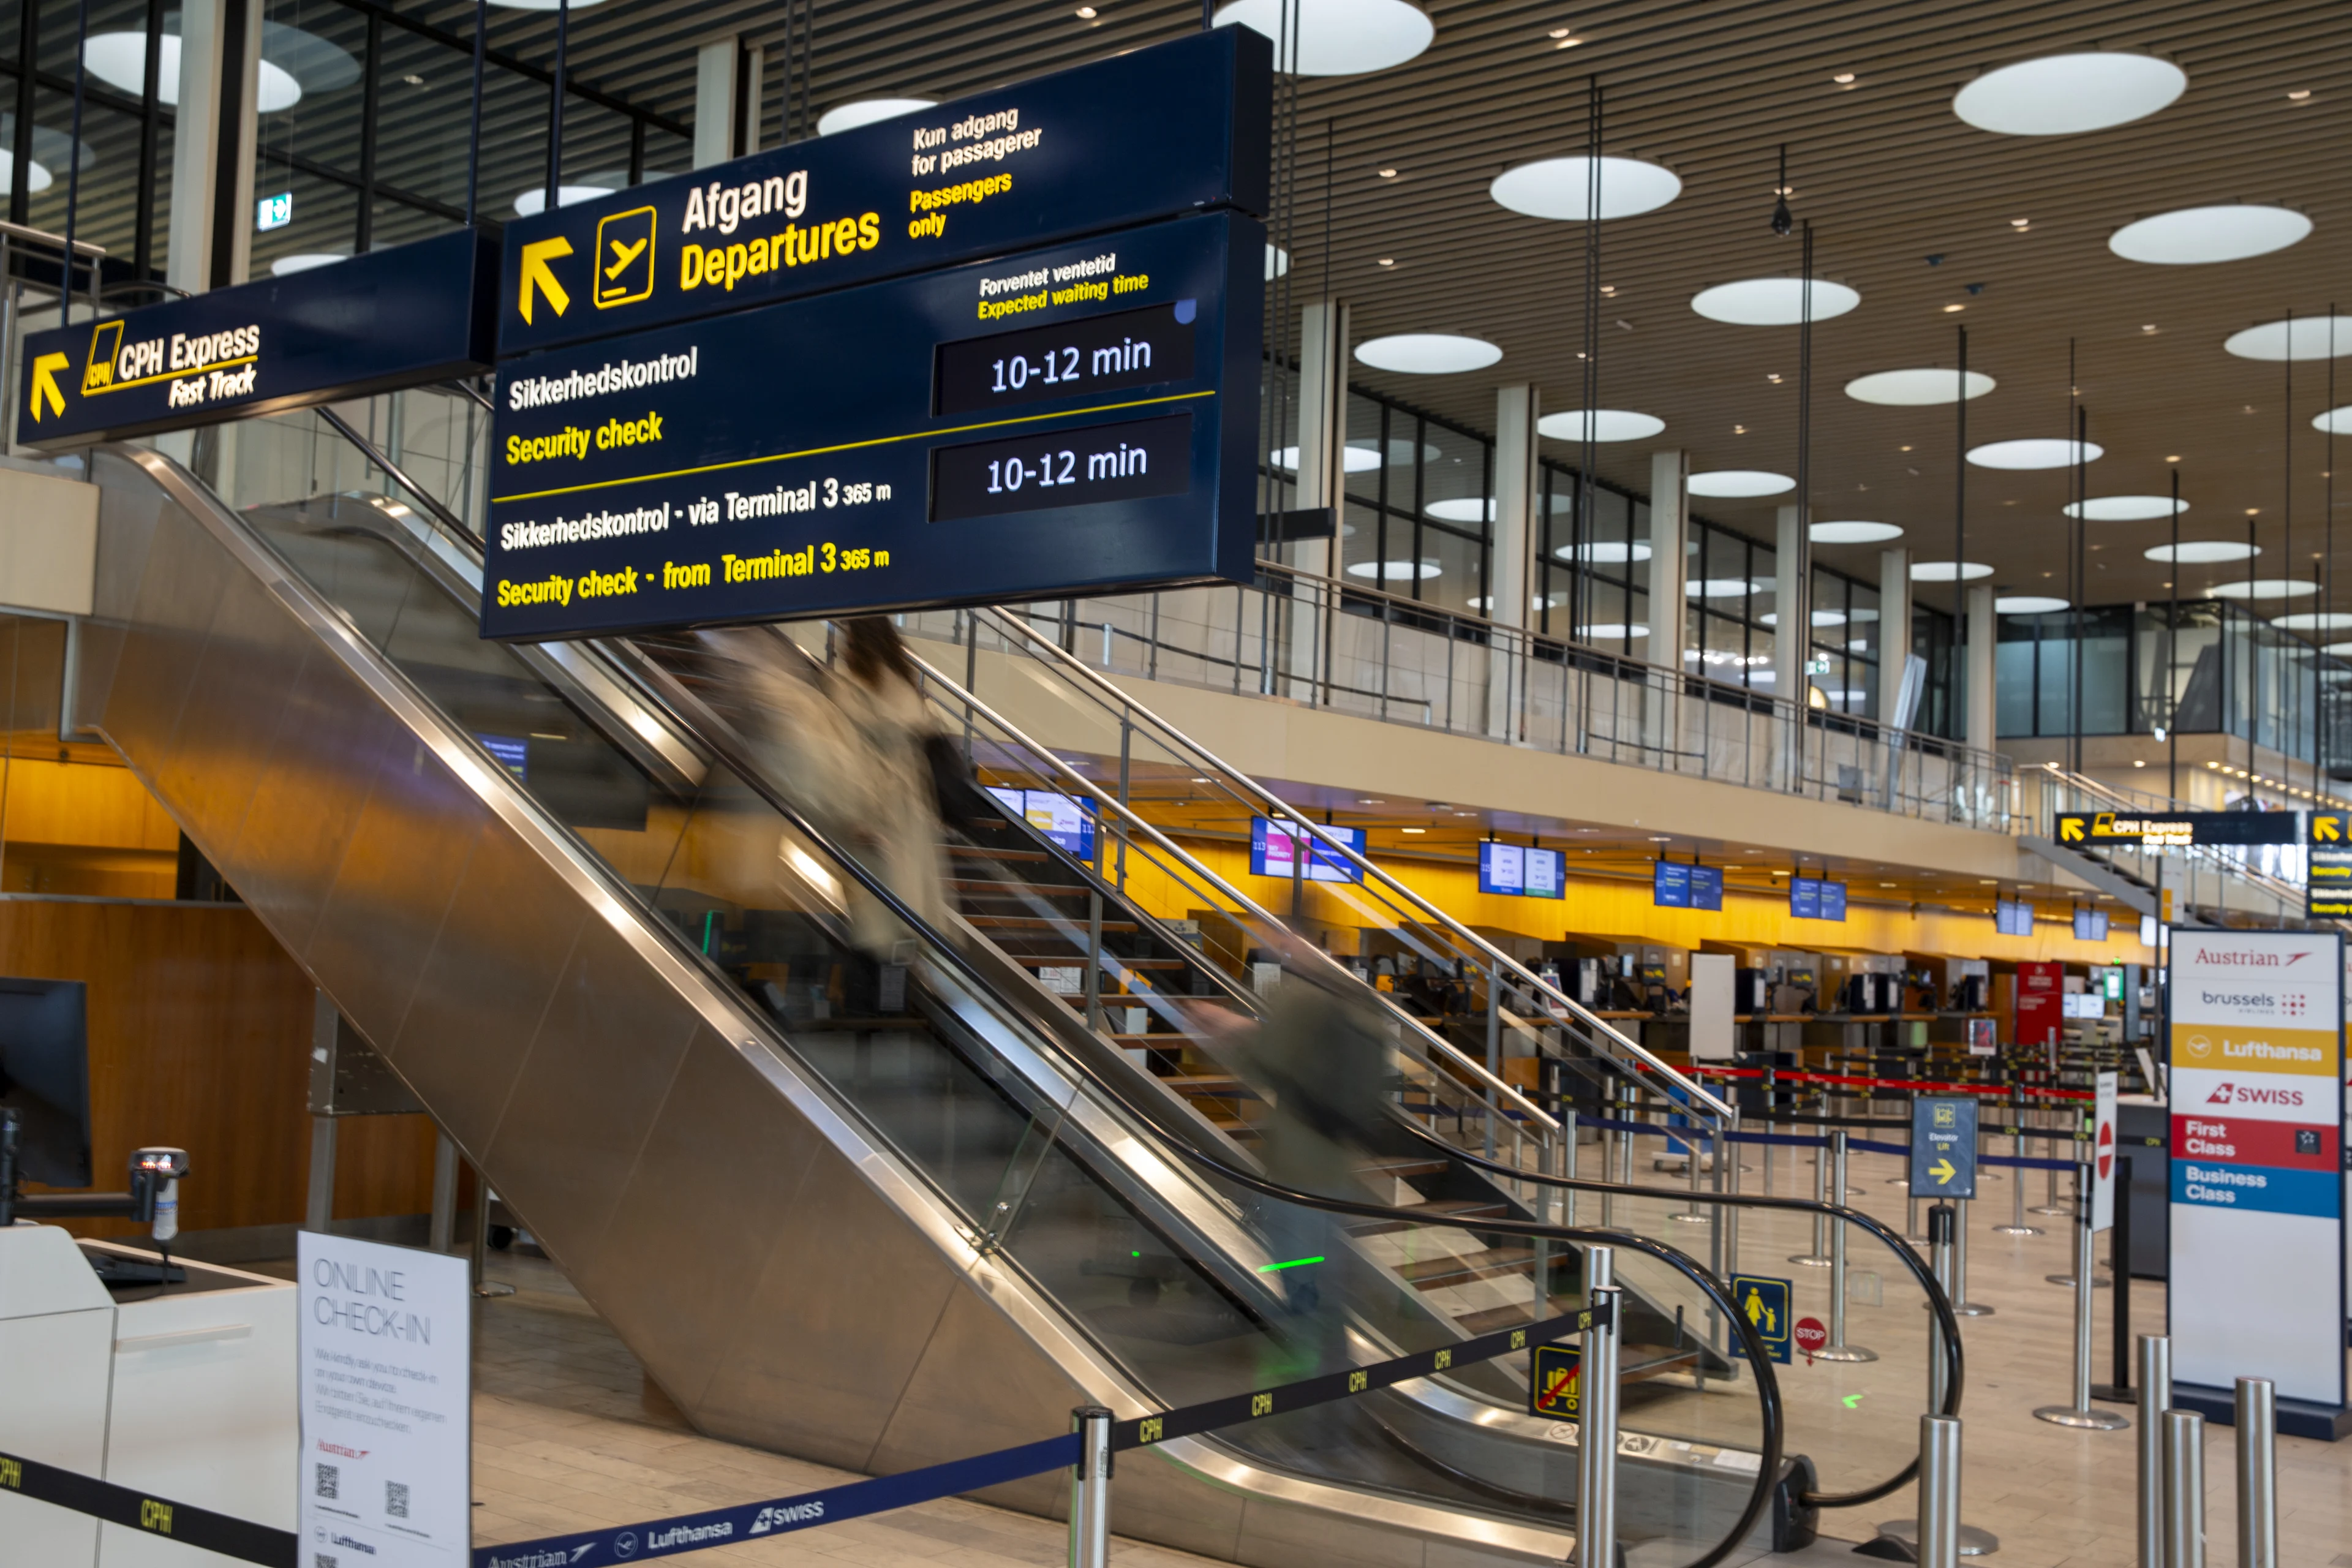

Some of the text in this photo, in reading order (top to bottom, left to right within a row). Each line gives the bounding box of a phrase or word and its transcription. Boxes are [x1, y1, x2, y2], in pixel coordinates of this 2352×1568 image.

[913, 108, 1019, 151] Kun adgang
[912, 127, 1042, 176] for passagerer
[682, 169, 808, 235] Afgang
[910, 172, 1012, 213] Passengers
[908, 212, 947, 239] only
[680, 211, 880, 291] Departures
[979, 252, 1116, 298] Forventet ventetid
[978, 274, 1149, 320] Expected waiting time
[119, 324, 260, 381] CPH Express
[992, 337, 1151, 393] 10-12 min
[89, 361, 111, 388] CPH
[168, 363, 257, 410] Fast Track
[509, 345, 698, 411] Sikkerhedskontrol
[506, 411, 663, 466] Security check
[987, 443, 1147, 494] 10-12 min
[500, 478, 891, 551] Sikkerhedskontrol - via Terminal 3 365 m
[497, 542, 889, 608] Security check - from Terminal 3 365 m
[2113, 820, 2193, 834] CPH Express
[2195, 948, 2278, 967] Austrian
[2203, 991, 2275, 1007] brussels
[2223, 1040, 2322, 1061] Lufthansa
[2237, 1087, 2304, 1106] SWISS
[1929, 1132, 1958, 1142] Elevator
[2185, 1120, 2226, 1138] First
[2185, 1139, 2236, 1157] Class
[2186, 1166, 2267, 1188] Business
[2185, 1185, 2236, 1203] Class
[314, 1258, 405, 1302] ONLINE
[314, 1296, 430, 1346] CHECK-IN
[1578, 1311, 1592, 1330] CPH
[1796, 1327, 1825, 1340] STOP
[1510, 1329, 1526, 1349] CPH
[1434, 1349, 1451, 1370] CPH
[1349, 1370, 1367, 1393] CPH
[1252, 1392, 1272, 1416] CPH
[1140, 1417, 1163, 1443] CPH
[316, 1438, 358, 1459] Austrian
[0, 1457, 21, 1489] PH
[141, 1499, 173, 1534] CPH
[773, 1501, 824, 1525] SWISS
[331, 1532, 377, 1556] Lufthansa
[648, 1521, 733, 1549] Lufthansa
[488, 1550, 567, 1568] Austrian
